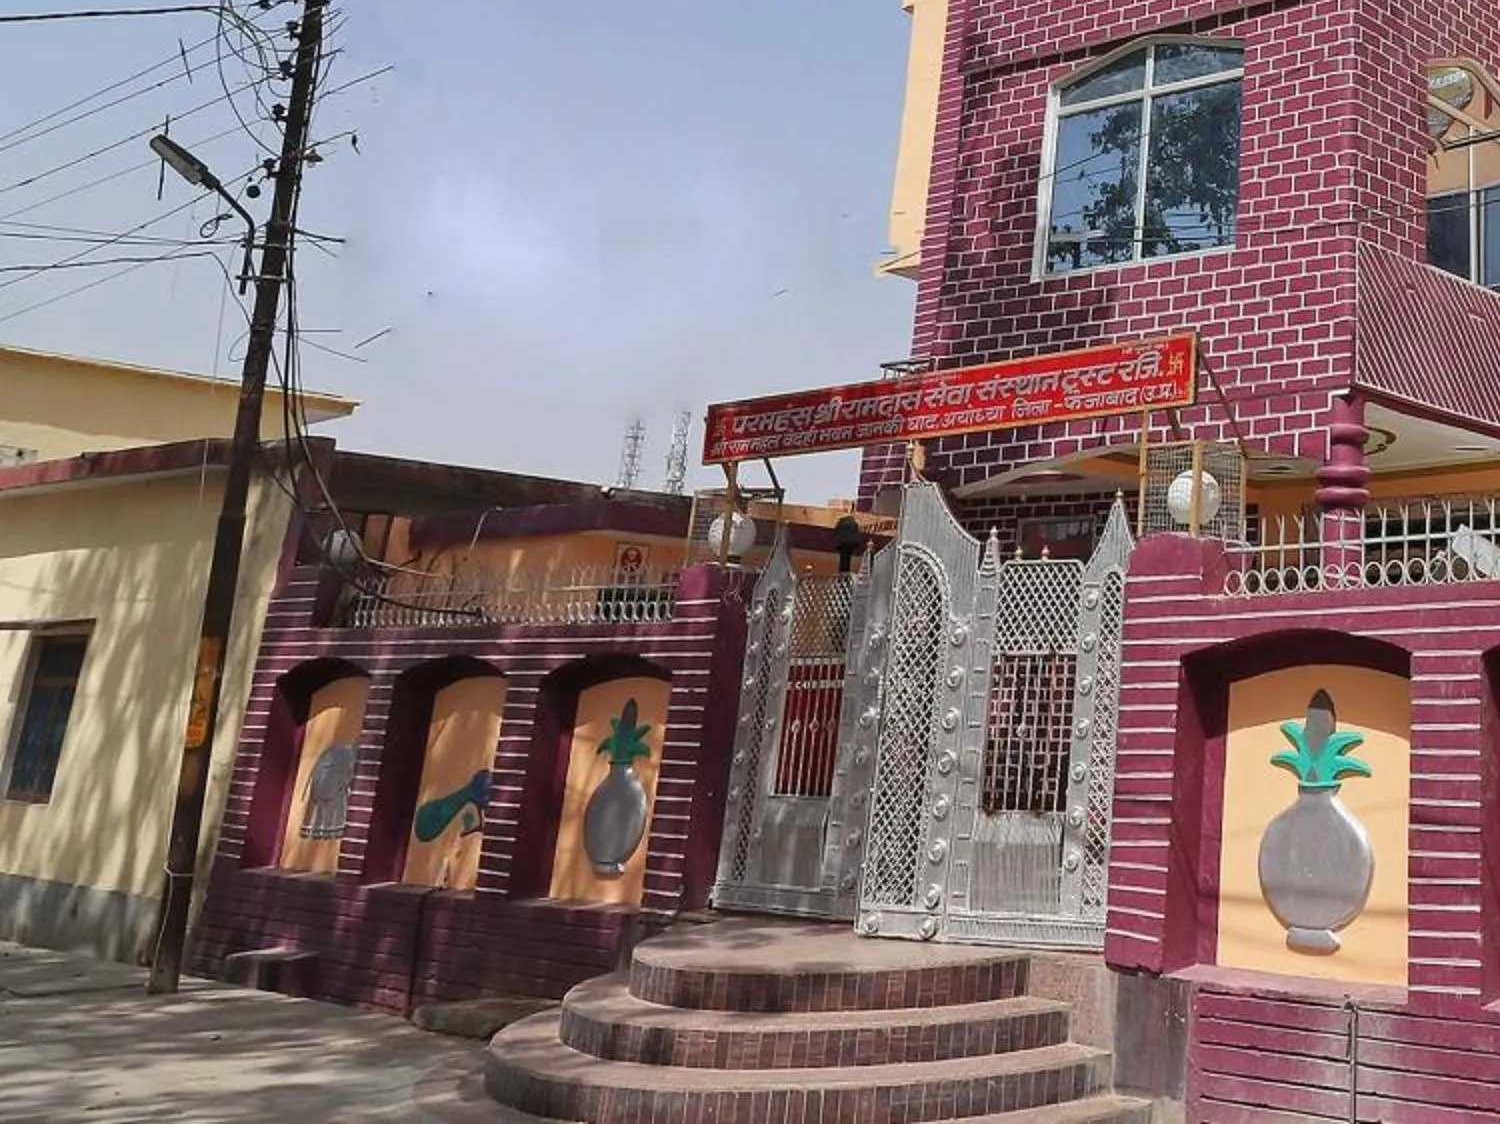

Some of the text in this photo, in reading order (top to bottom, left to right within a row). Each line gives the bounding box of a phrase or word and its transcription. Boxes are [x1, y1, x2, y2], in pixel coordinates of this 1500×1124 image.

[732, 402, 815, 433] परमहंस
[923, 380, 976, 409] सेवा
[976, 373, 1062, 401] संस्थान
